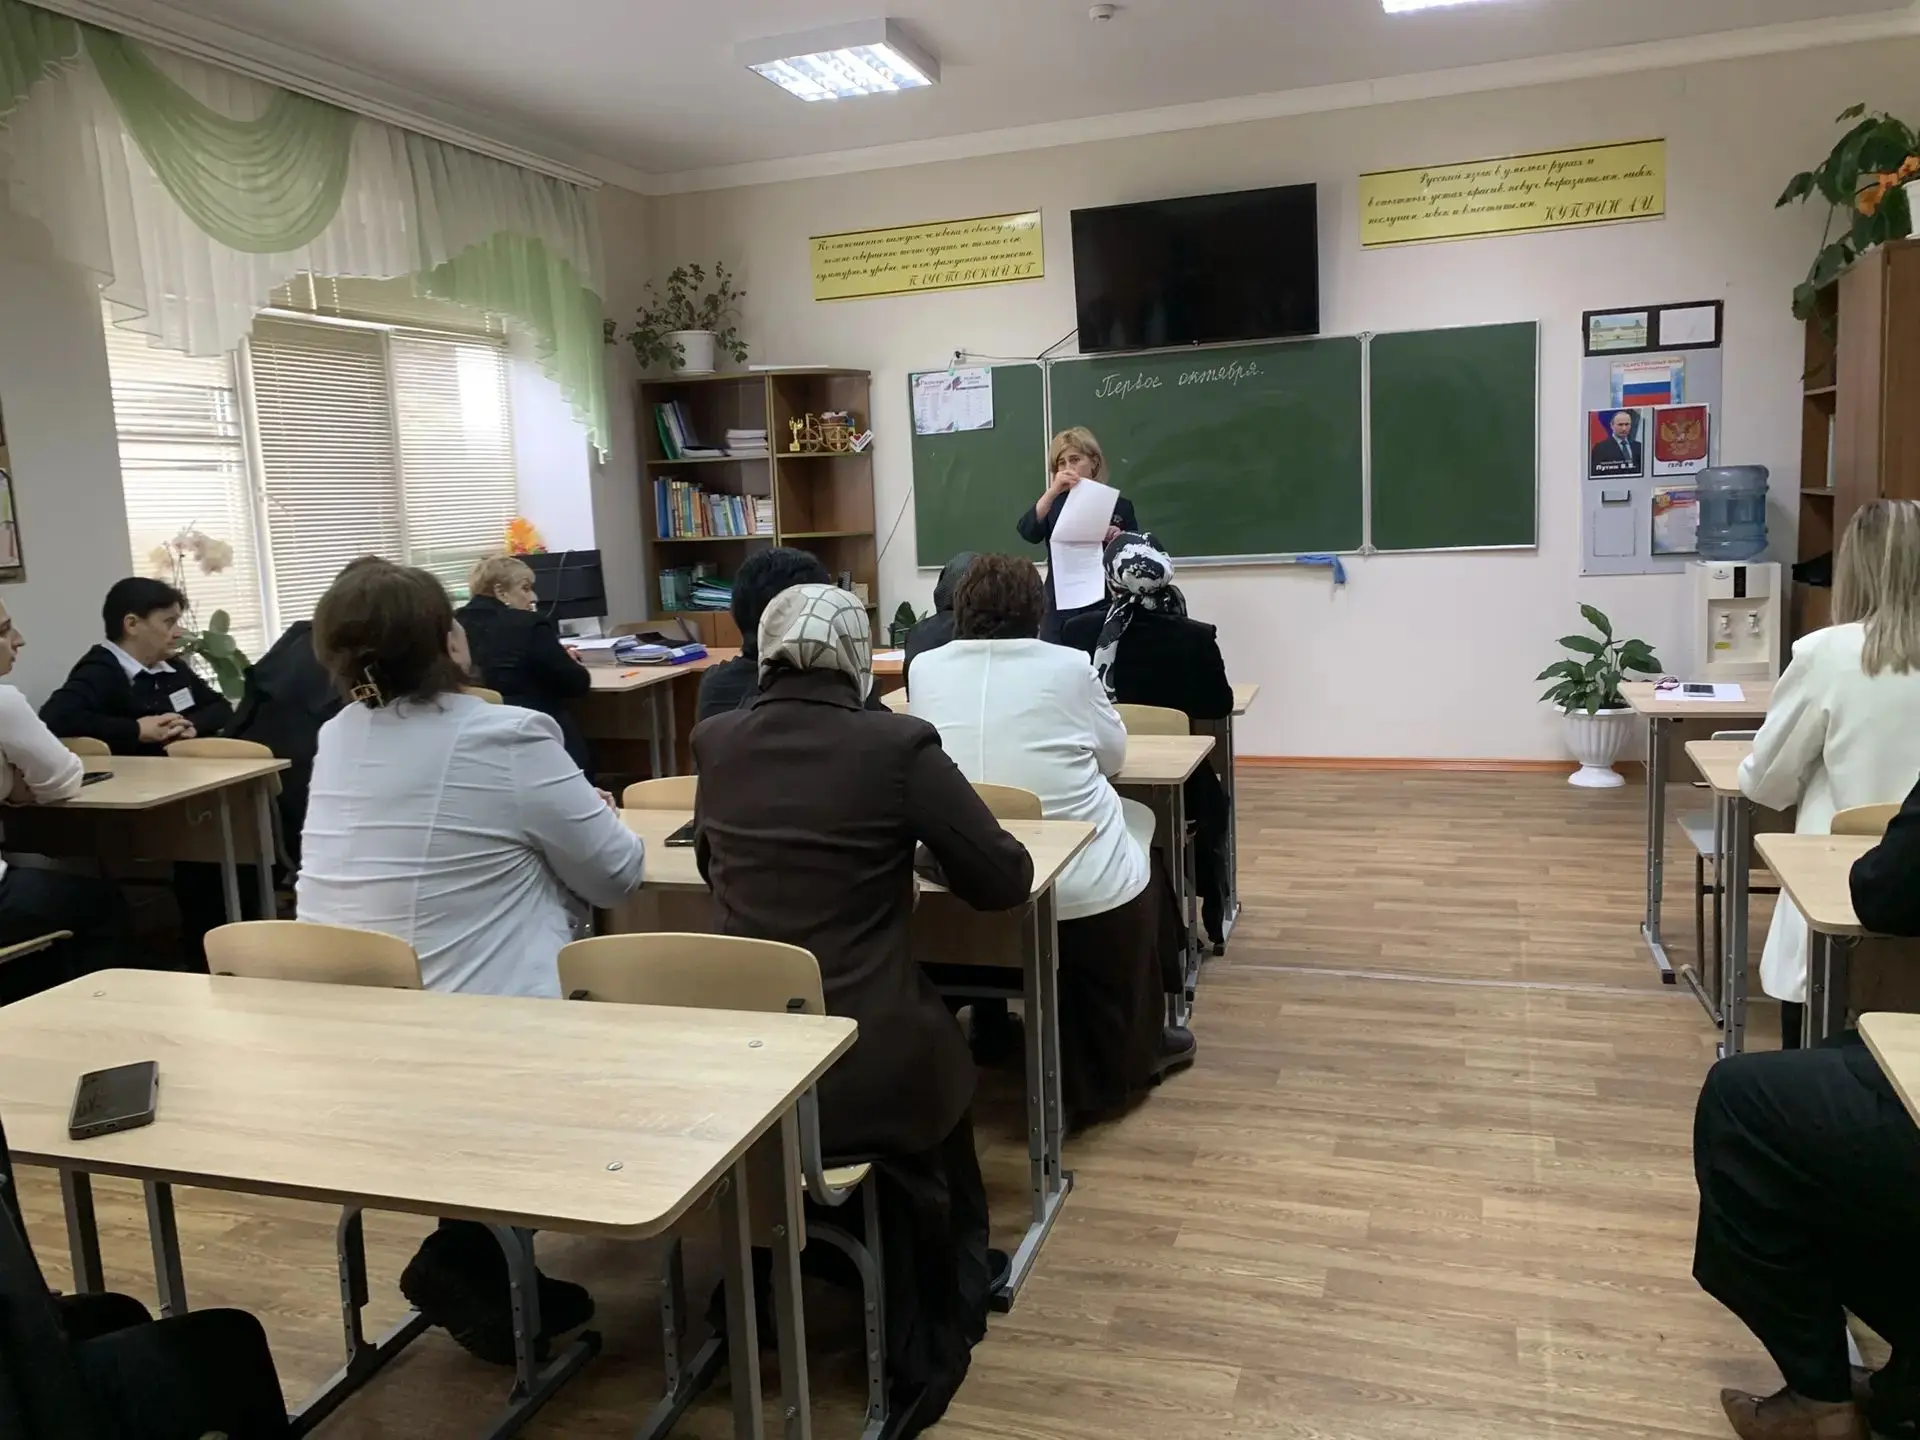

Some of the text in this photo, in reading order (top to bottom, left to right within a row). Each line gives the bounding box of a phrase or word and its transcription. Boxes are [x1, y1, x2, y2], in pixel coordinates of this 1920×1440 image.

[1420, 171, 1461, 188] Русский
[1464, 170, 1491, 182] язык
[1494, 164, 1502, 175] в
[1503, 164, 1547, 179] умелых
[1548, 160, 1583, 175] руках
[1543, 197, 1622, 222] КУПРИН
[971, 224, 1003, 235] своему
[852, 251, 897, 263] совершенно
[1095, 371, 1163, 400] Первое
